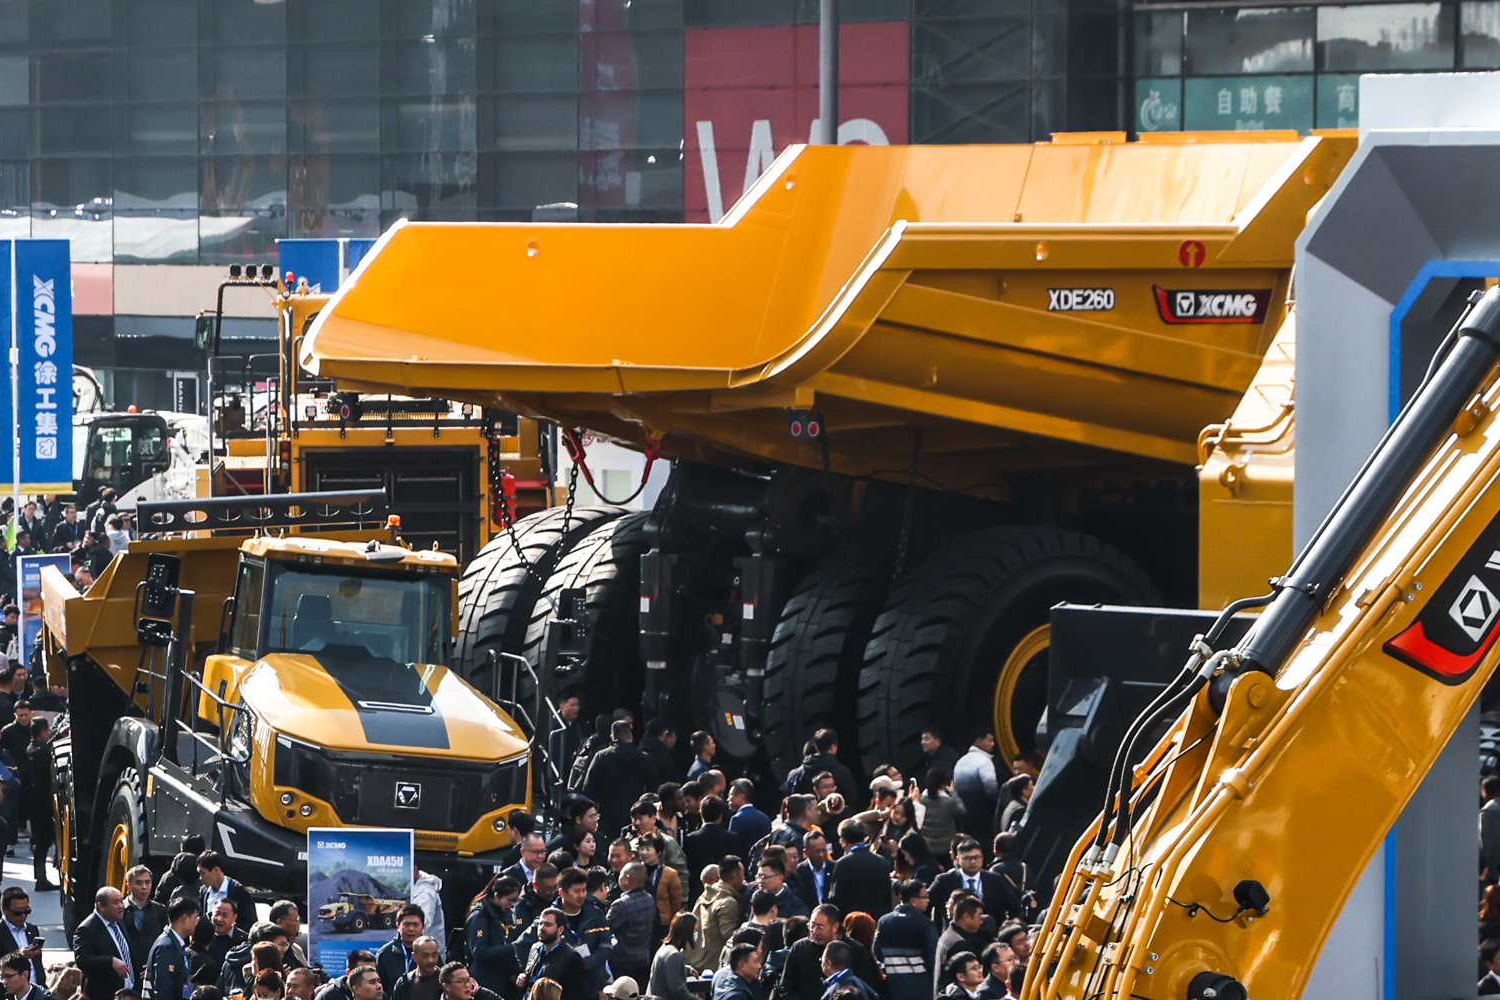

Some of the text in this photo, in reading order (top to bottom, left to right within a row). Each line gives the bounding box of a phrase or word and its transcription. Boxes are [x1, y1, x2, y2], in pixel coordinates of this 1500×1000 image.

[1218, 86, 1282, 114] 自助餐
[1048, 288, 1115, 310] XDE260
[1196, 294, 1257, 317] XCMG
[33, 274, 57, 358] XCMG
[34, 360, 58, 460] 徐工集团
